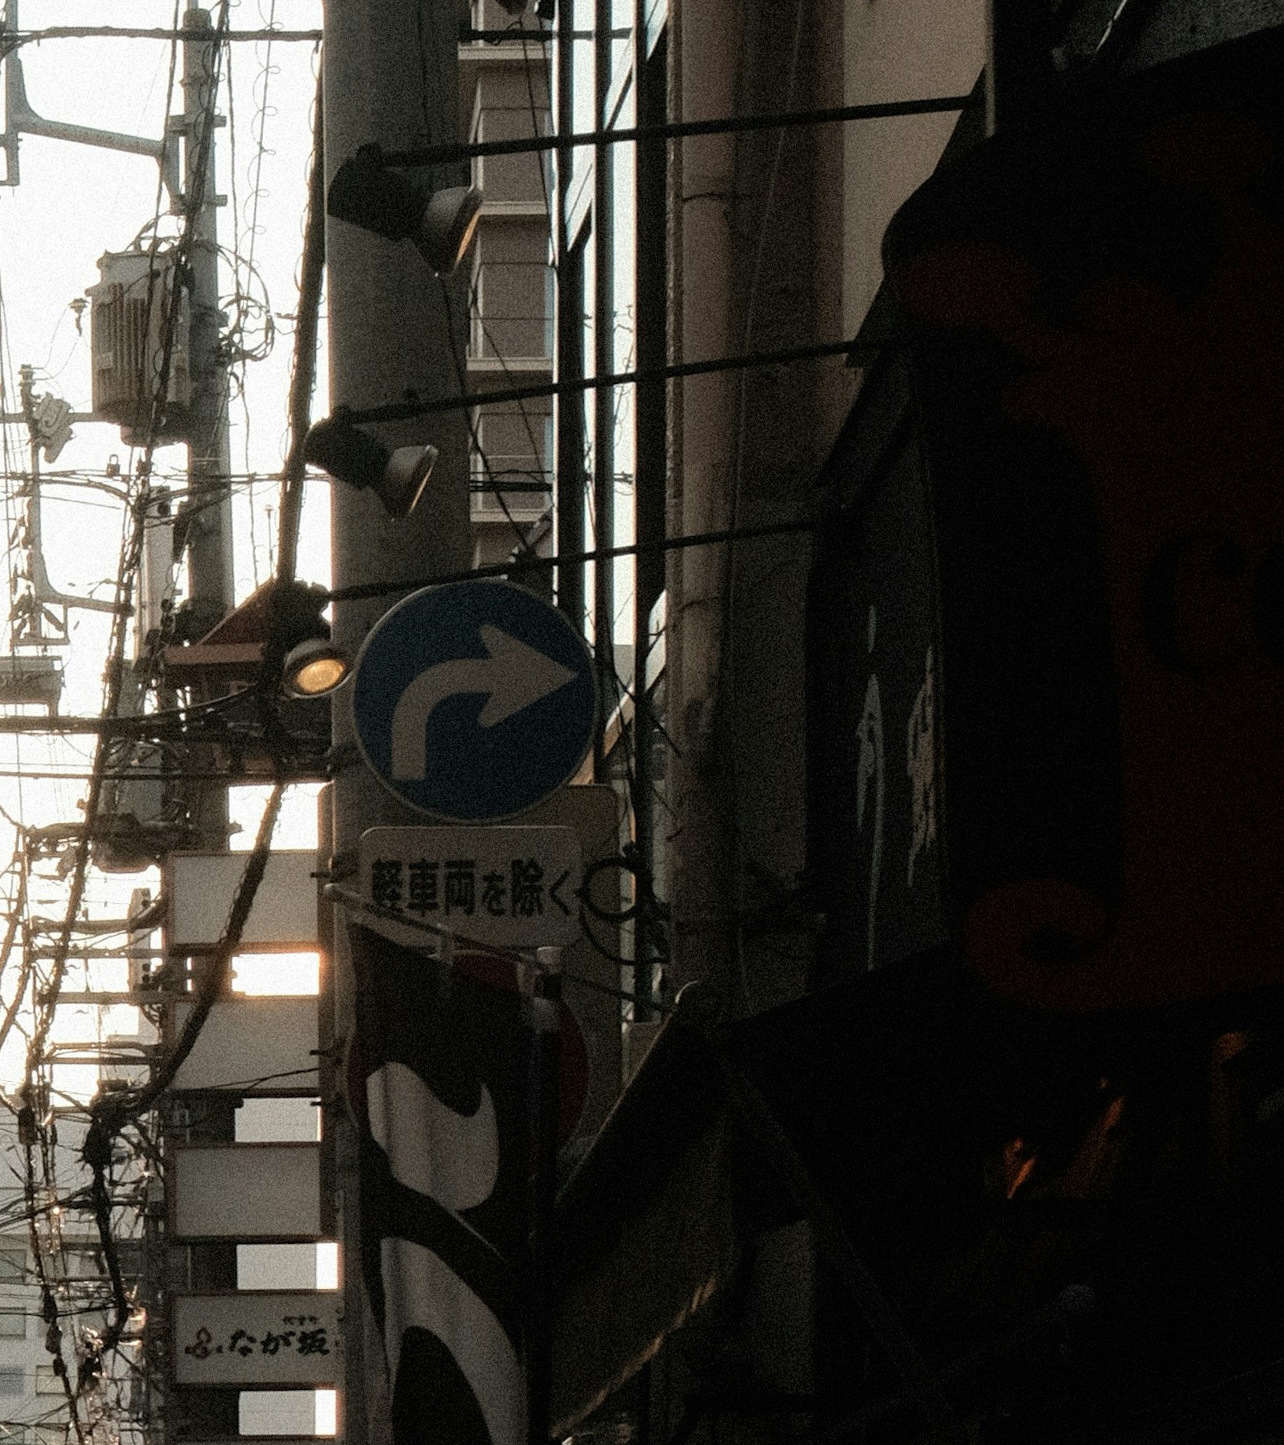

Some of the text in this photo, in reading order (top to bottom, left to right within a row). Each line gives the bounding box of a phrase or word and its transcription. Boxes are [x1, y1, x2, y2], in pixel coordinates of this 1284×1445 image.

[371, 858, 570, 917] 軽車両を除く
